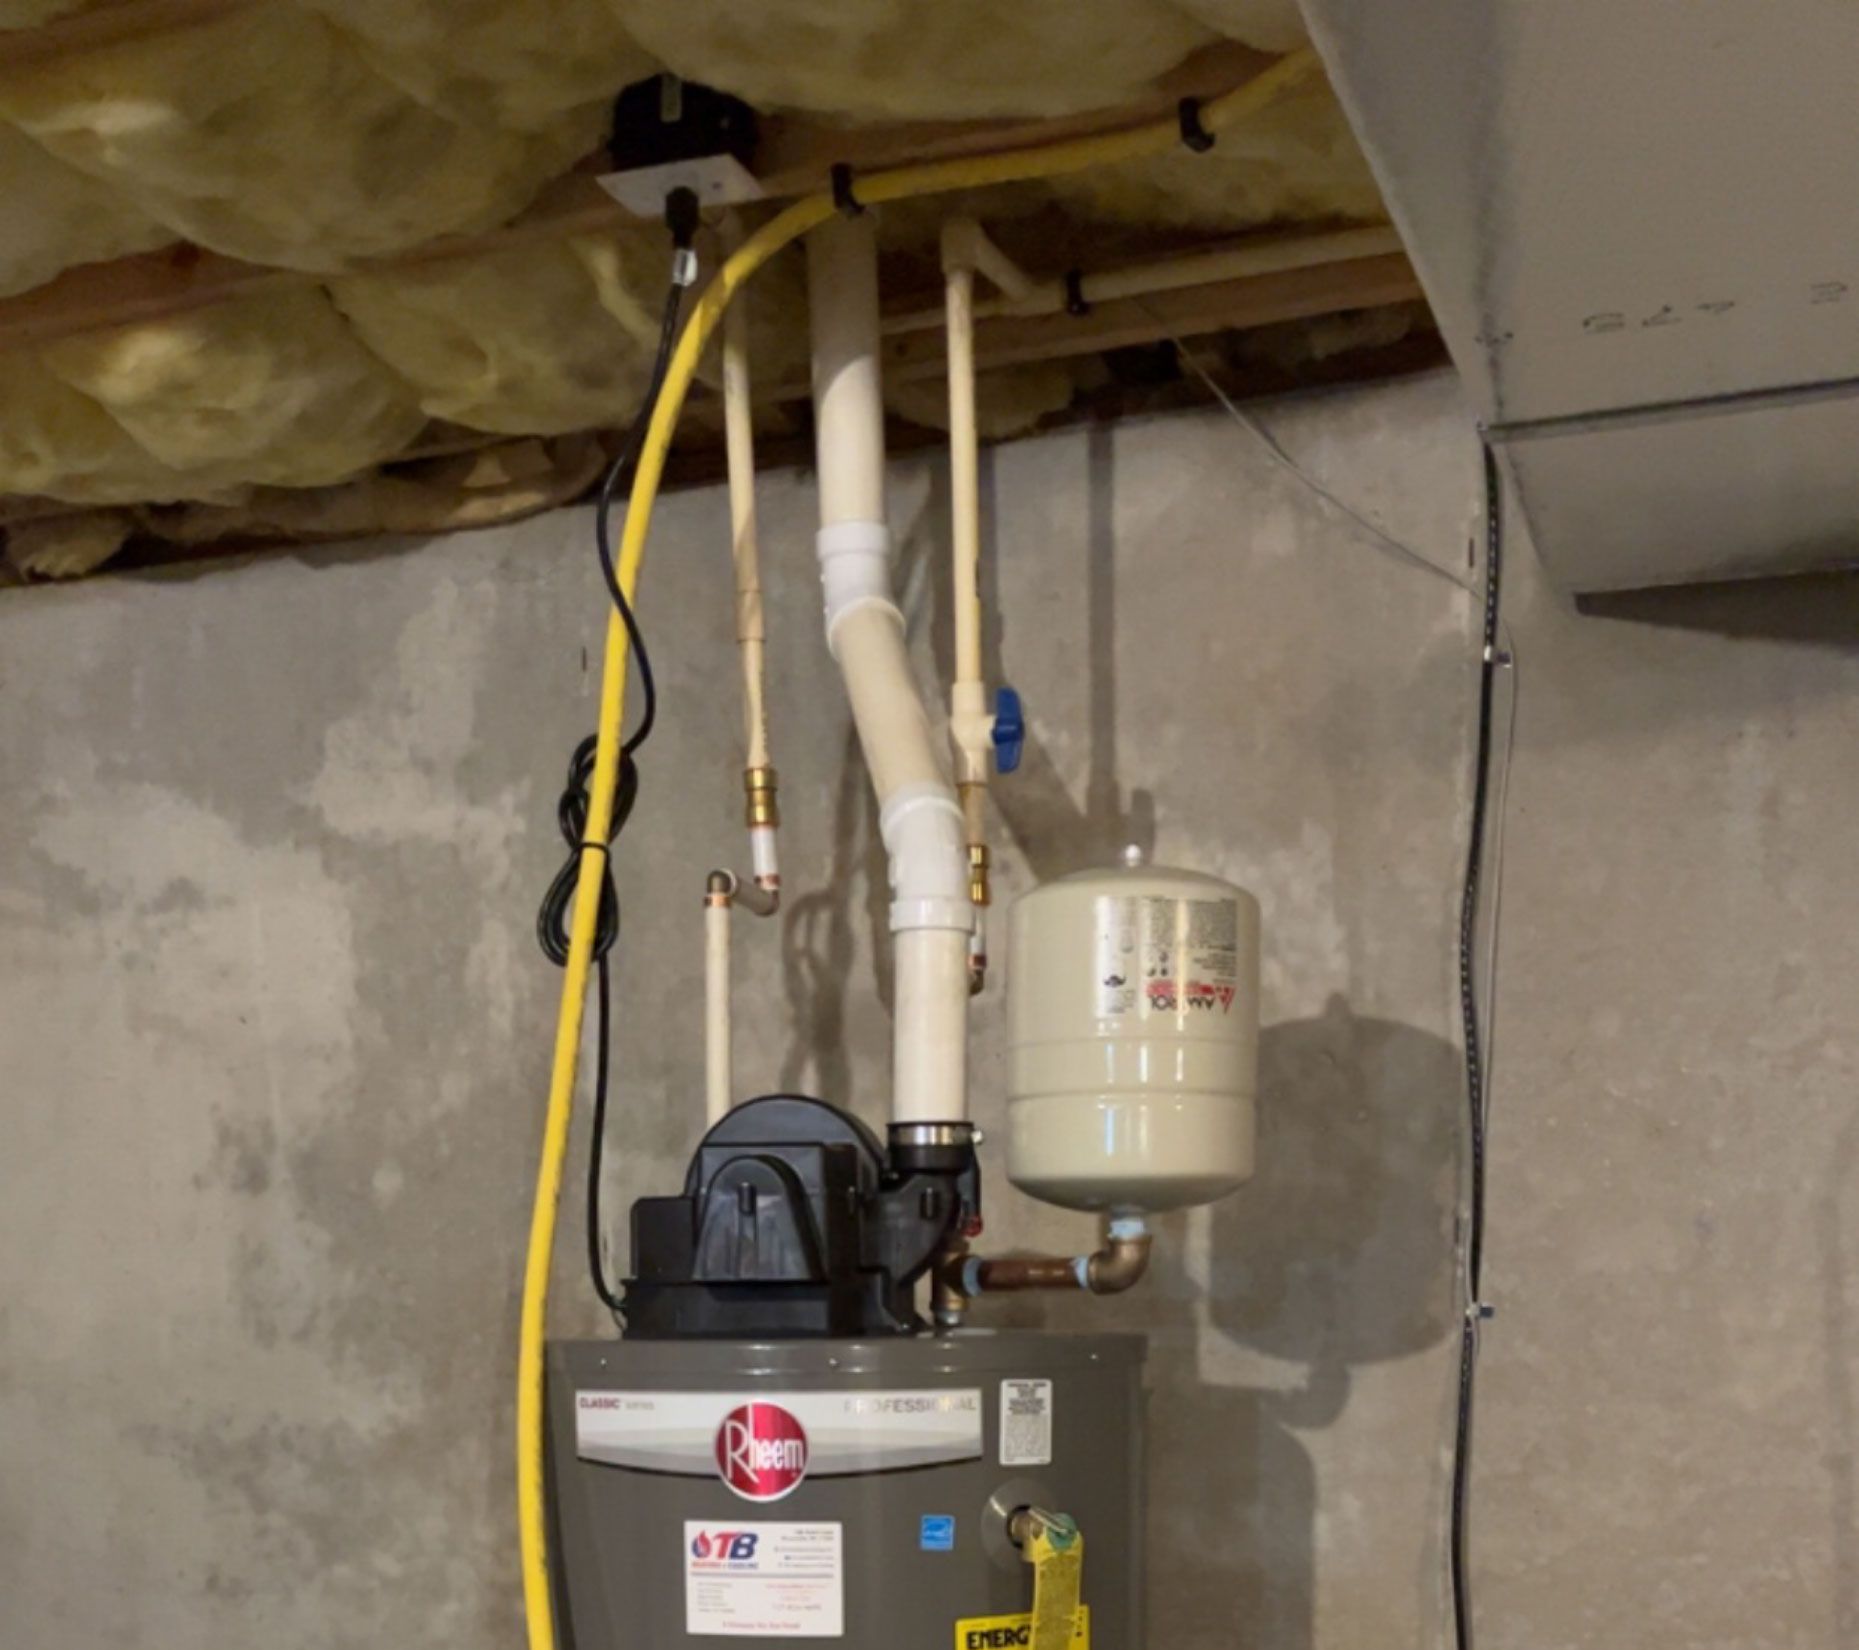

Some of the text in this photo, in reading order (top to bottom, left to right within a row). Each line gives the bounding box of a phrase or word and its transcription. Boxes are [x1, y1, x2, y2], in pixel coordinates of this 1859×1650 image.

[1151, 995, 1215, 1011] AMROL
[843, 1397, 977, 1414] POFESSIOAL
[725, 1402, 804, 1483] Rheem
[713, 1531, 758, 1560] TB
[966, 1624, 1031, 1650] ENERG
